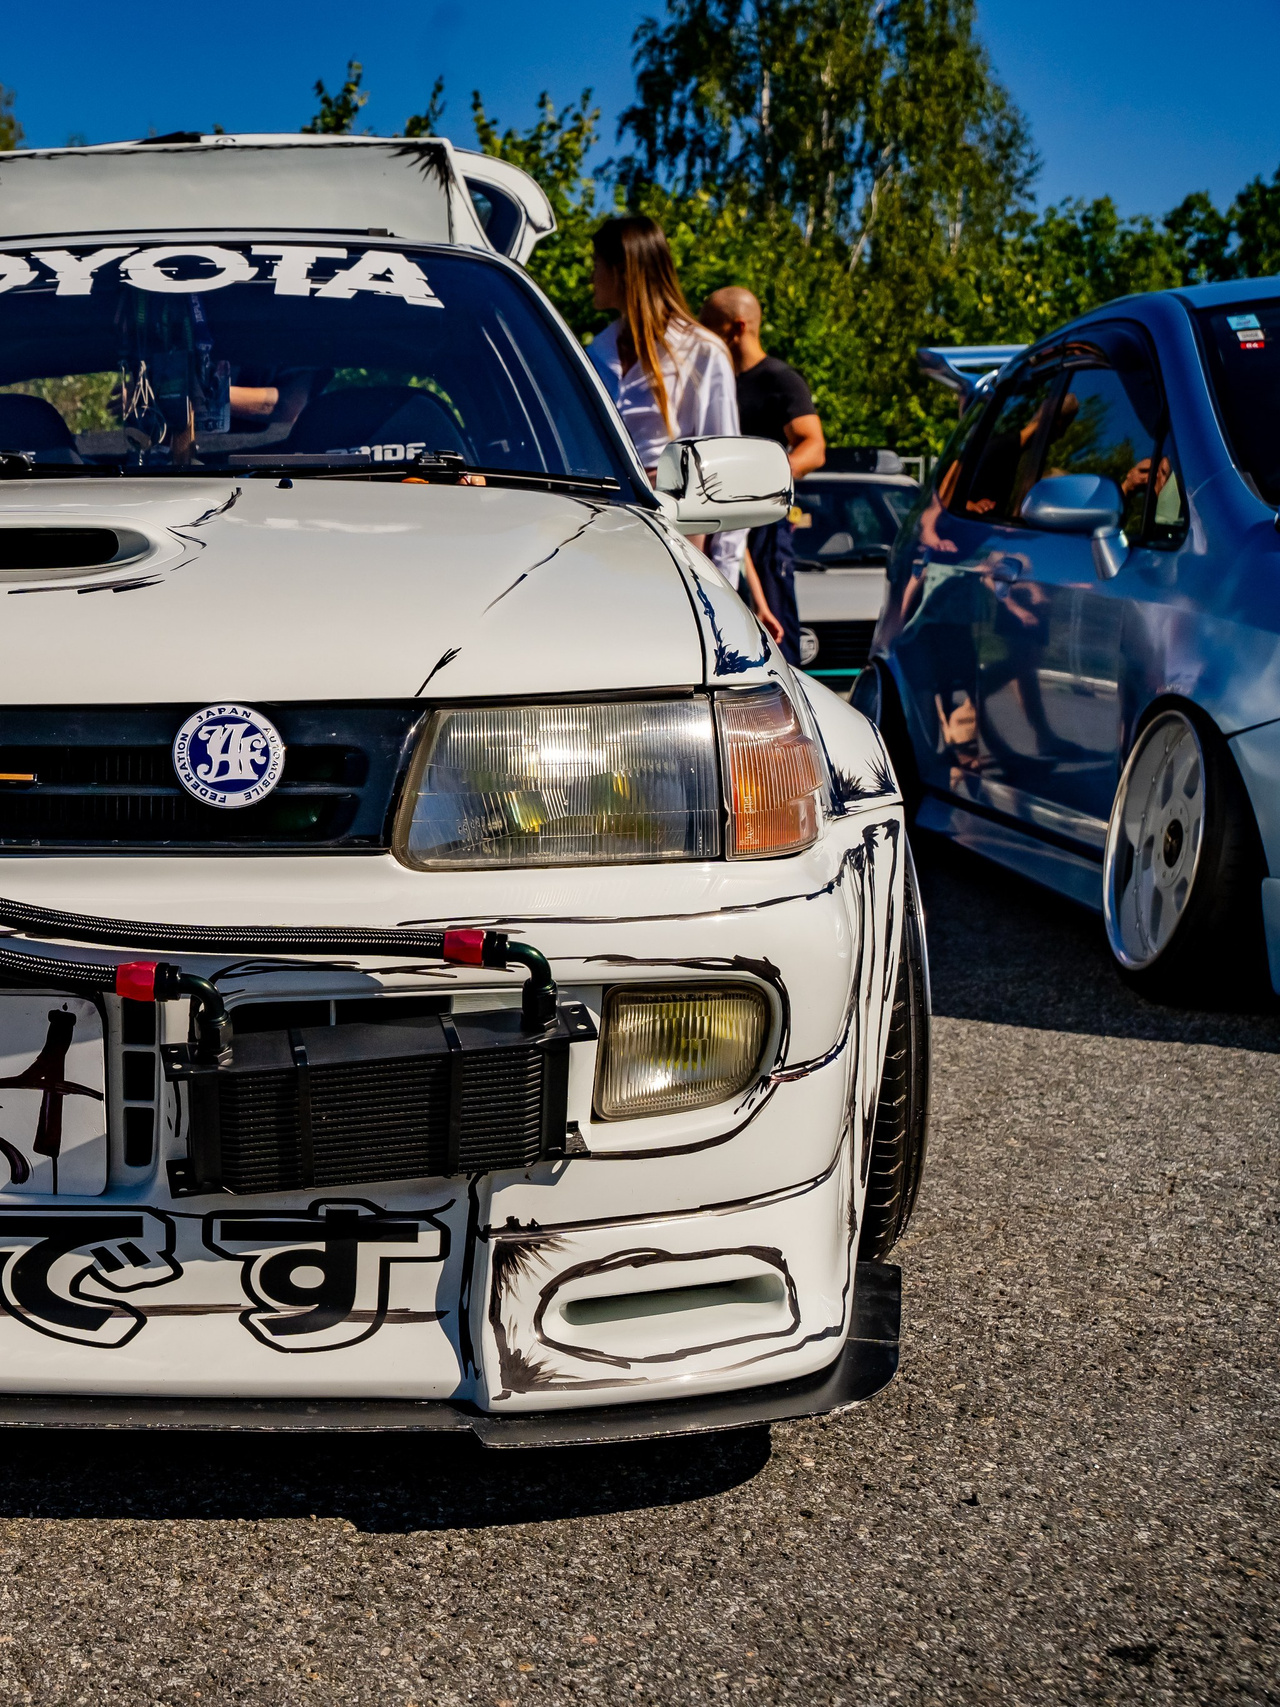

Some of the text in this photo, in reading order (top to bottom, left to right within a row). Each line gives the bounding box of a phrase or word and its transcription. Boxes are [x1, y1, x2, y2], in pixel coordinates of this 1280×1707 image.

[177, 707, 282, 803] JAPAN AUTOMOBILE FEDERATION
